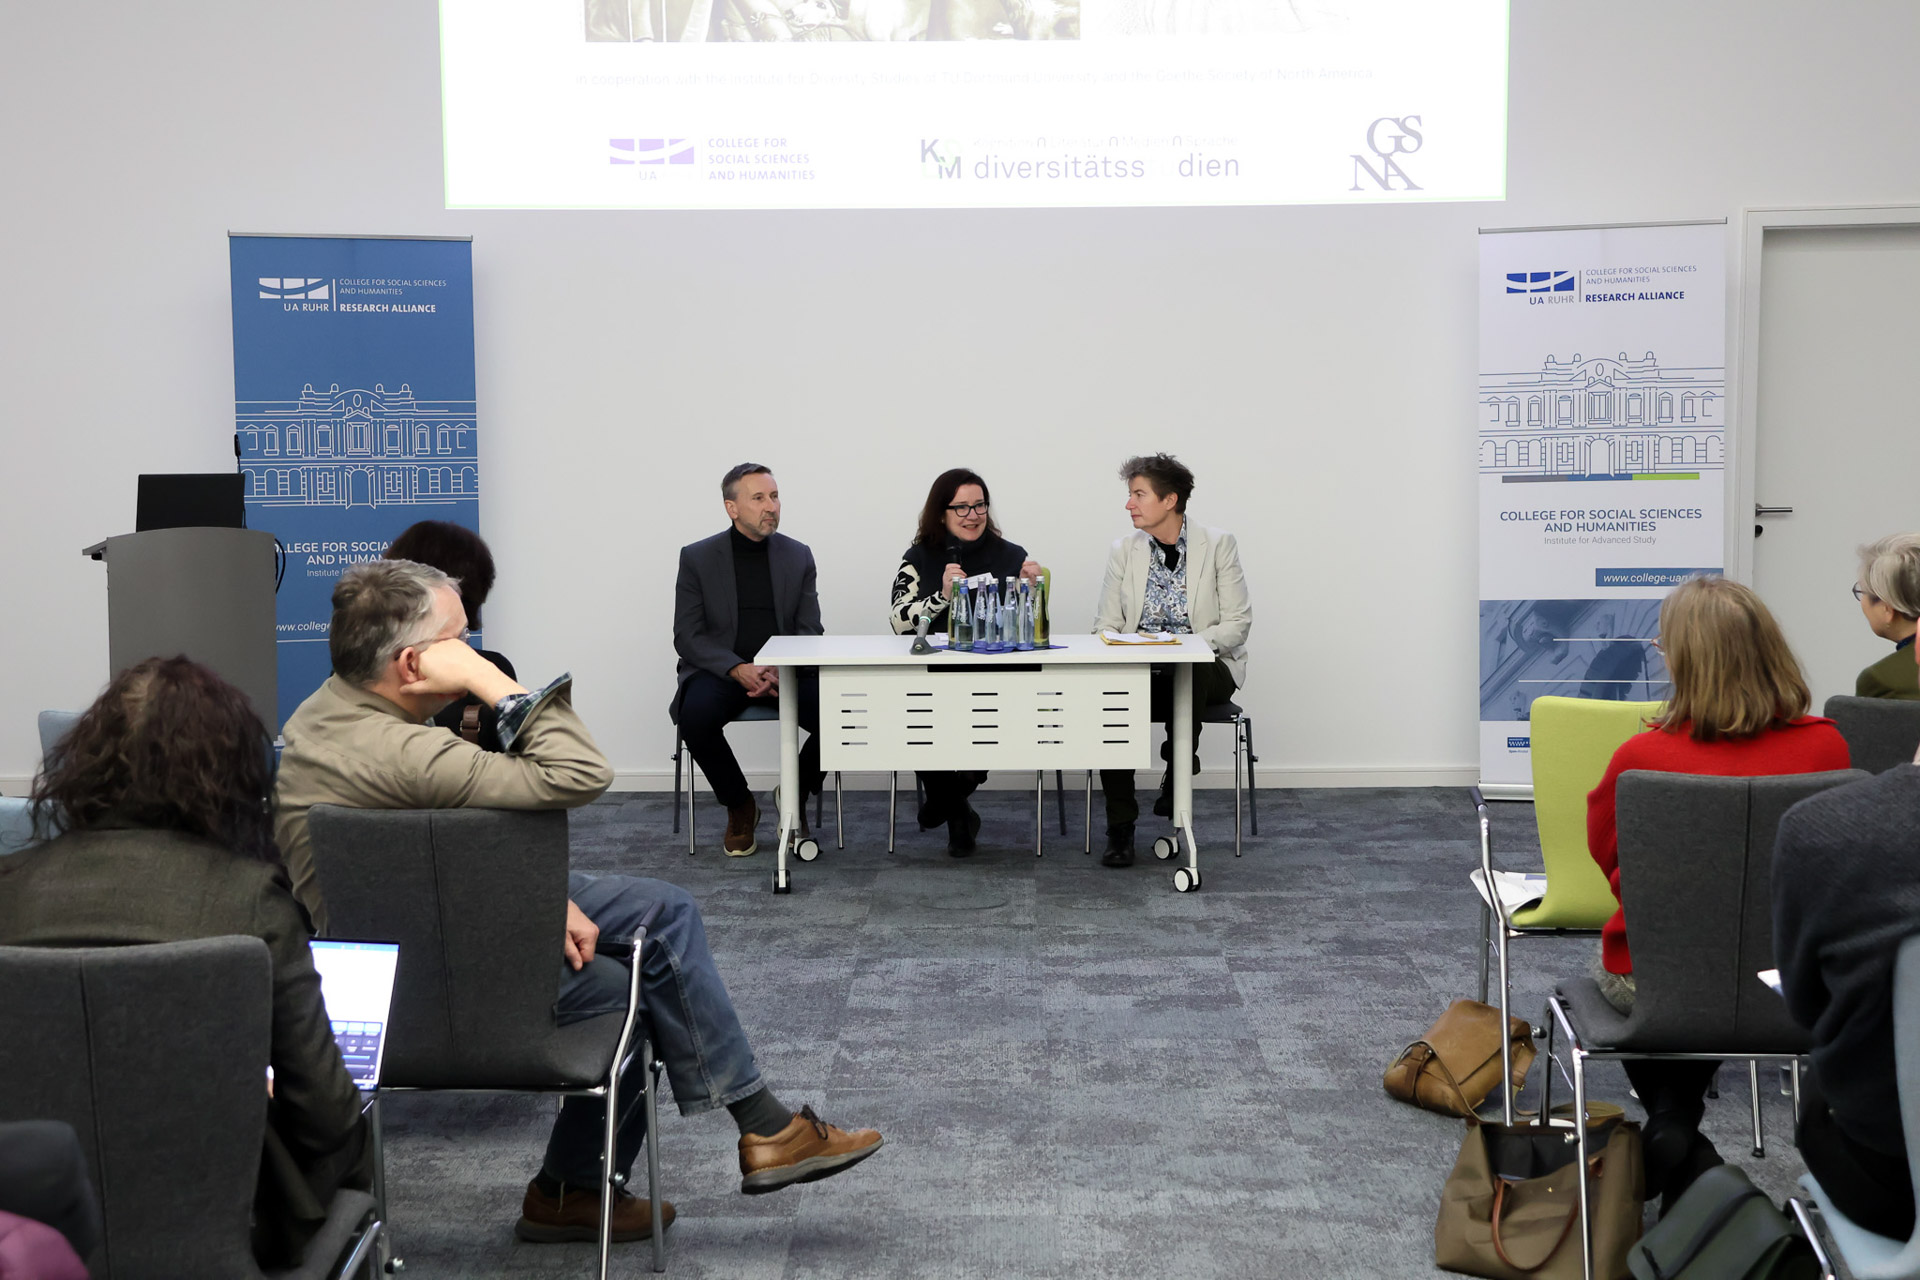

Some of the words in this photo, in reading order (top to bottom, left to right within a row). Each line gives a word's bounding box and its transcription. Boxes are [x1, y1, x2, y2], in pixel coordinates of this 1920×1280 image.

[708, 138, 759, 148] COLLEGE
[764, 138, 787, 148] FOR
[708, 154, 750, 164] SOCIAL
[754, 153, 810, 164] SCIENCES
[708, 170, 735, 181] AND
[739, 170, 816, 180] HUMANITIES
[1586, 268, 1617, 276] COLLEGE
[1618, 267, 1633, 275] FOR
[1634, 266, 1661, 275] SOCIAL
[1662, 265, 1697, 273] SCIENCES
[339, 278, 371, 287] COLLEGE
[371, 278, 387, 287] FOR
[387, 279, 412, 287] SOCIAL
[413, 279, 447, 287] SCIENCES
[1586, 277, 1603, 285] AND
[1604, 276, 1650, 284] HUMANITIES
[357, 288, 403, 296] HUMANITIES
[1585, 292, 1635, 302] RESEARCH
[1638, 291, 1685, 301] ALLIANCE
[1529, 297, 1545, 305] UA
[1548, 295, 1575, 305] RUHR
[283, 303, 299, 312] UA
[302, 303, 329, 312] RUHR
[340, 303, 389, 313] RESEARCH
[391, 304, 436, 313] ALLIANCE
[1500, 510, 1556, 521] COLLEGE
[1560, 510, 1585, 520] FOR
[1589, 509, 1636, 520] SOCIAL
[1639, 508, 1703, 519] SCIENCES
[1544, 522, 1573, 532] AND
[1576, 521, 1656, 532] HUMANITIES
[1544, 536, 1577, 545] Institute
[1578, 536, 1590, 544] for
[1592, 535, 1632, 545] Advanced
[1633, 535, 1657, 546] Study
[322, 541, 348, 552] FOR
[351, 541, 393, 552] SOCIA
[306, 554, 335, 565] AND
[306, 569, 340, 577] Institute
